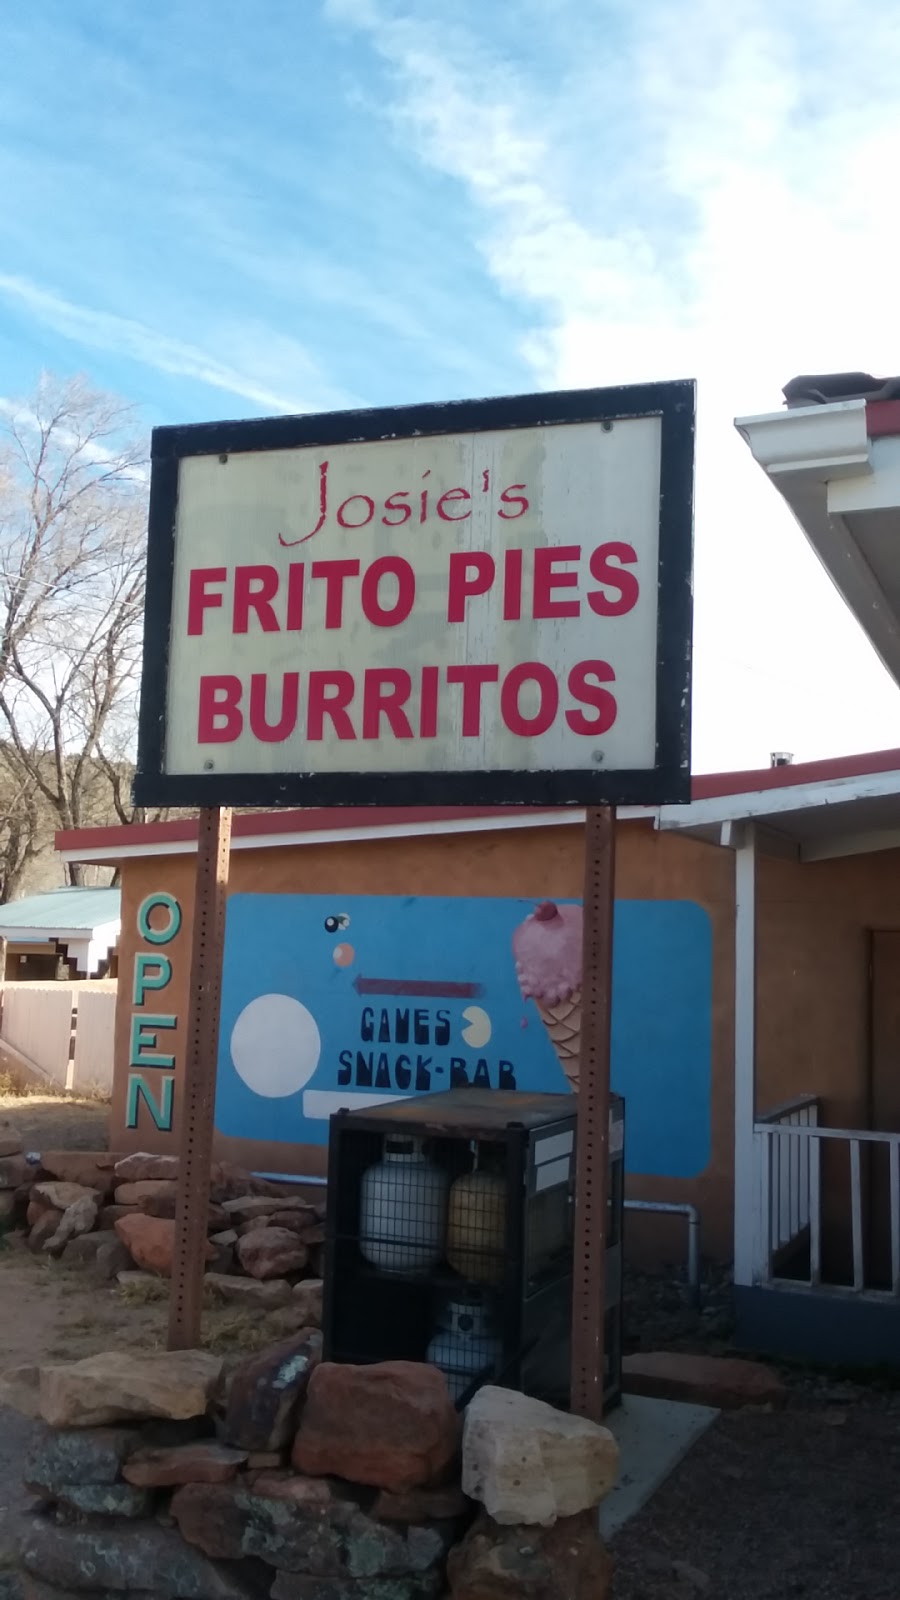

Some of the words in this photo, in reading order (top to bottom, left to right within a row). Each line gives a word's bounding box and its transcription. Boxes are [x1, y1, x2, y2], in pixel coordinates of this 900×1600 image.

[278, 461, 530, 547] Josie's
[187, 555, 416, 636] FRITO
[446, 541, 640, 623] PIES
[197, 659, 618, 744] BURRITOS
[125, 891, 182, 1132] OPEN
[361, 1007, 451, 1046] GAMES
[337, 1050, 516, 1091] SNACK-BAR
